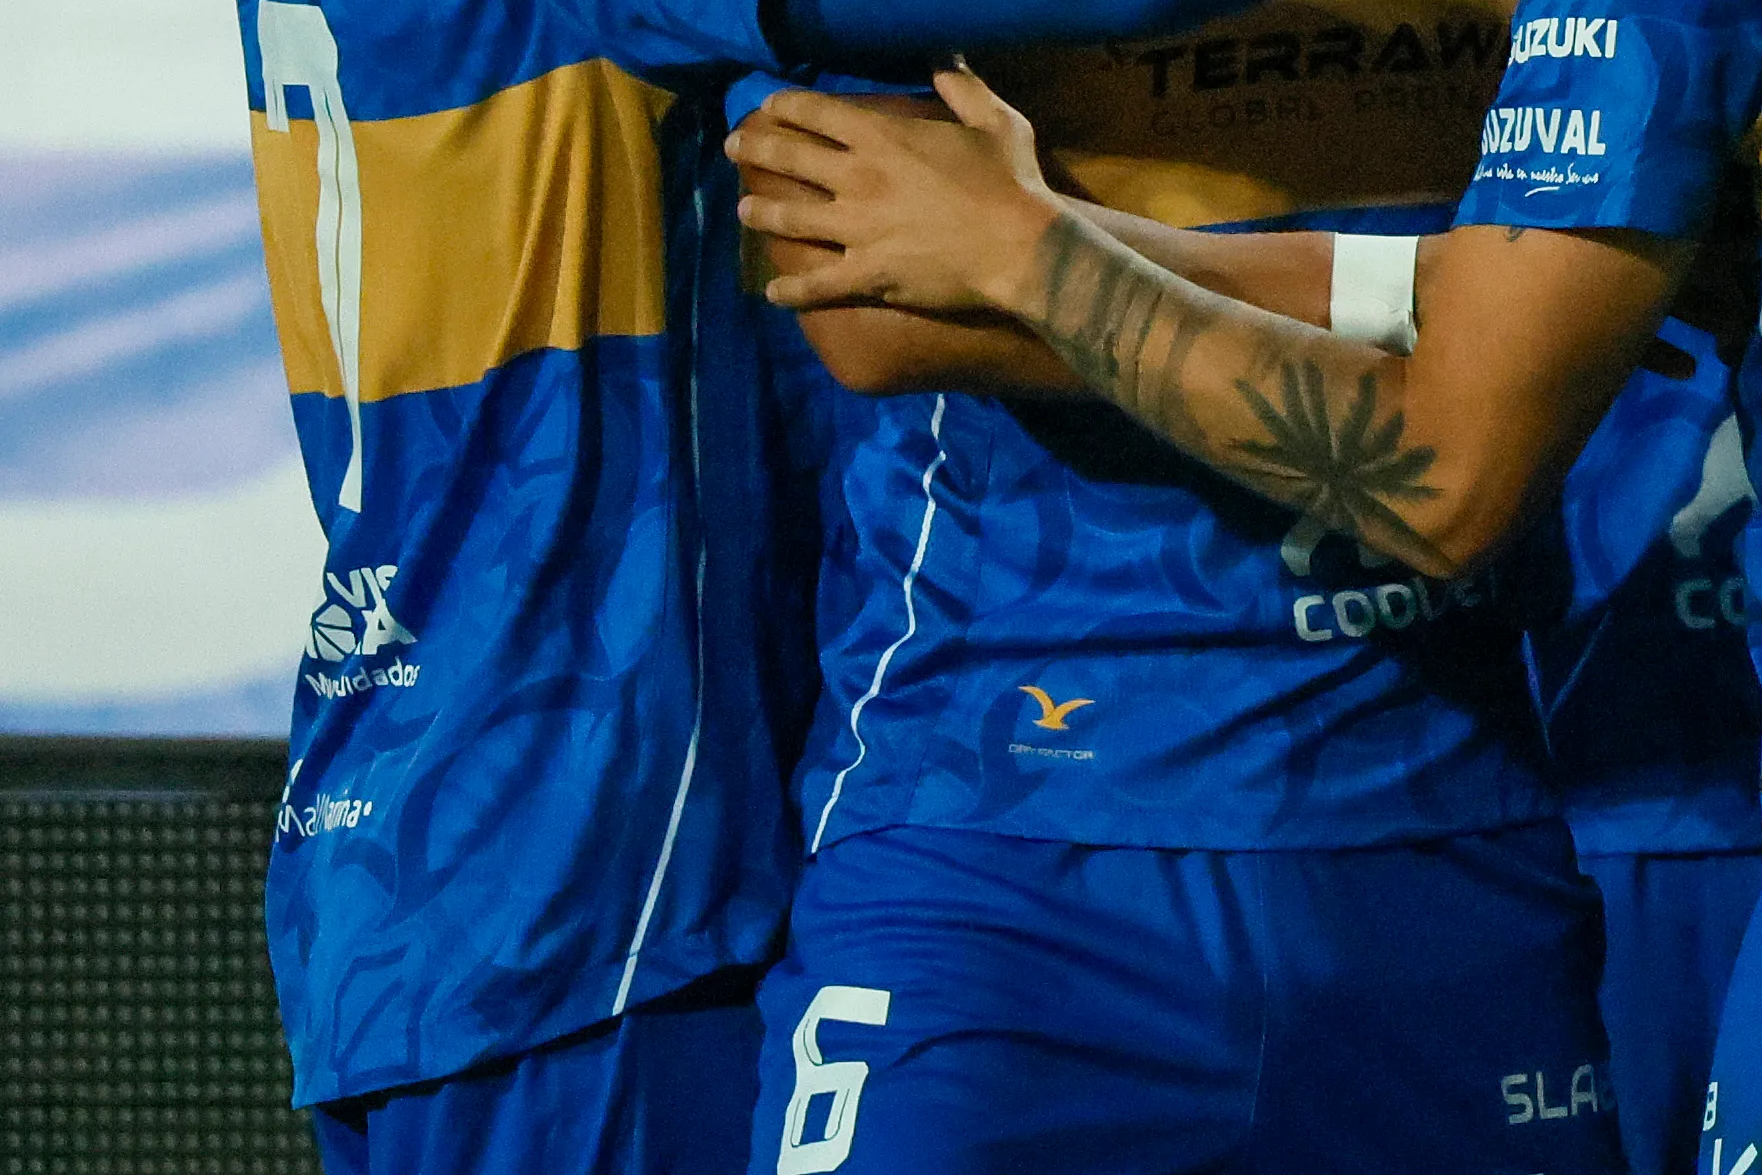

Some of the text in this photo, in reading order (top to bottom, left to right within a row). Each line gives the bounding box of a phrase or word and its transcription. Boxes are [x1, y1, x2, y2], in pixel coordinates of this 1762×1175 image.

[1136, 20, 1503, 100] TERRAW
[777, 985, 891, 1174] 6
[1500, 1063, 1599, 1126] SLA
